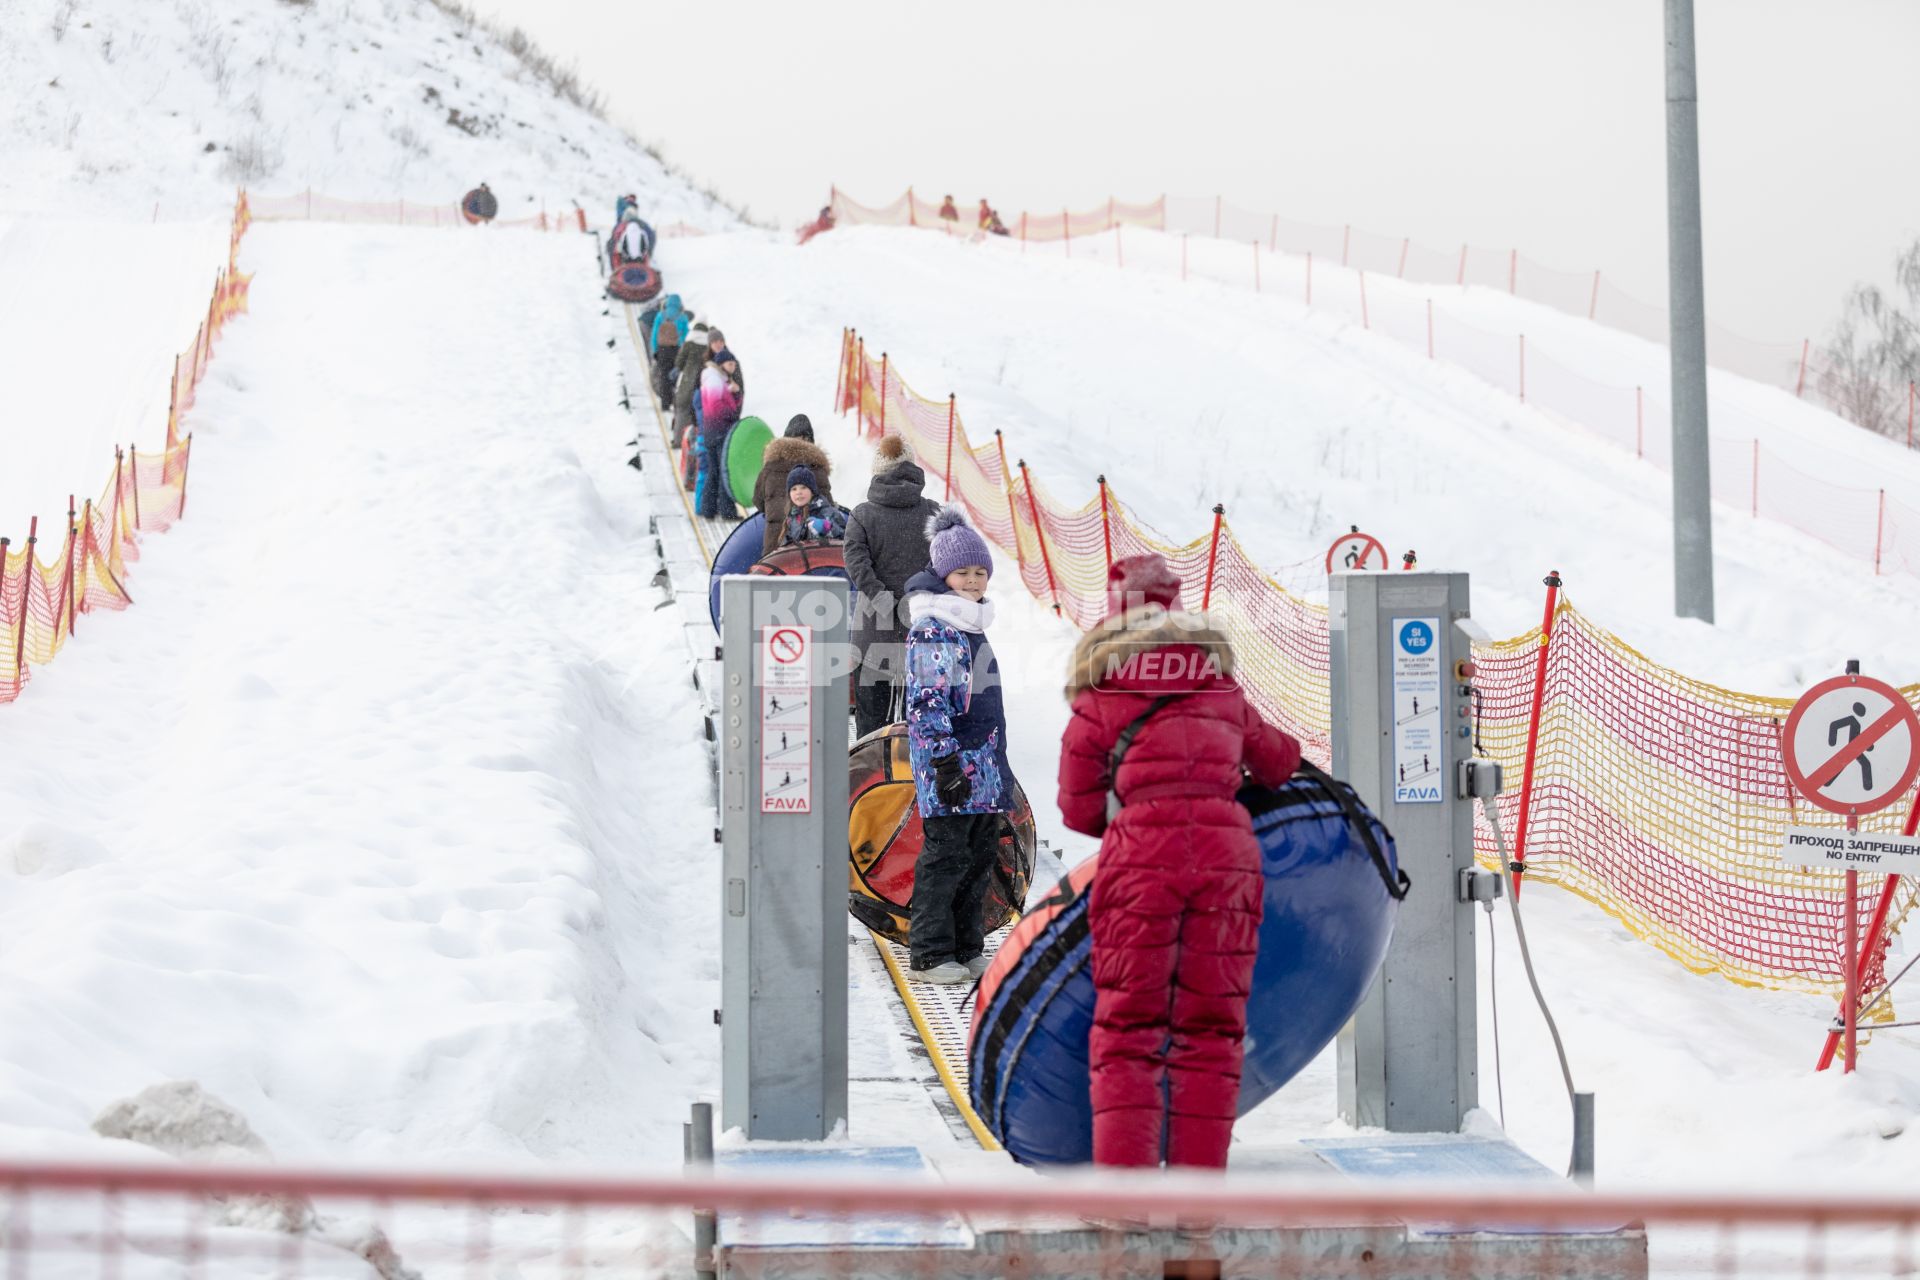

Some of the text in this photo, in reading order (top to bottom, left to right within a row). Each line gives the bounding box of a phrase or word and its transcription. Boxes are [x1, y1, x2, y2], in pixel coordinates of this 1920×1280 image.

[1406, 637, 1427, 647] YES
[1398, 788, 1440, 799] FAVA
[764, 797, 807, 810] FAVA
[1789, 834, 1920, 856] ПРОХОД ЗАПРЕЩЕН
[1826, 850, 1882, 863] NO ENTRY
